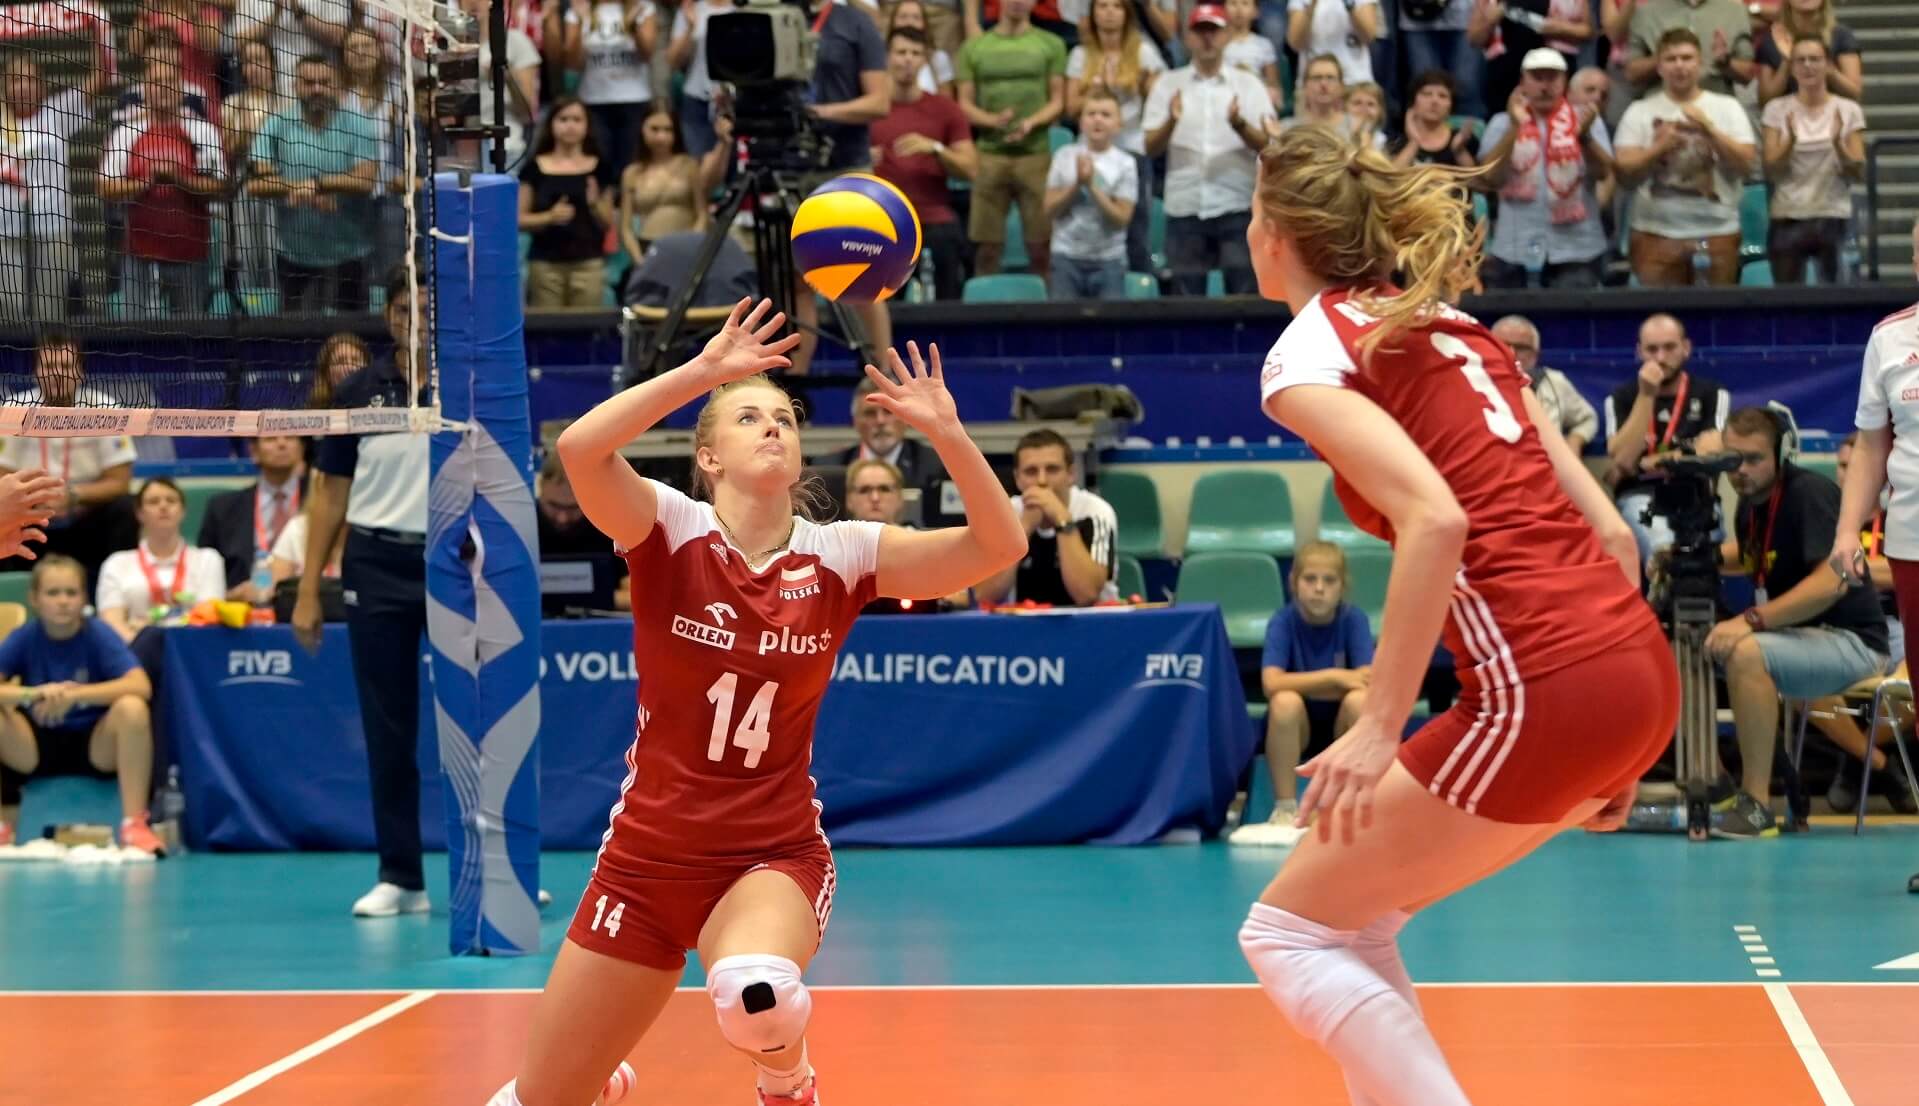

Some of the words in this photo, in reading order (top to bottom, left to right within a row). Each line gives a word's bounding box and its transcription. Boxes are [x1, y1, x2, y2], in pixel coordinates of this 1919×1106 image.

[1430, 332, 1522, 443] 3
[779, 583, 821, 600] POLSKA
[675, 619, 731, 647] ORLEN
[228, 650, 292, 675] FIVB
[835, 652, 1065, 685] ALIFICATION
[1145, 653, 1204, 678] FIVB
[706, 672, 779, 769] 14
[591, 895, 626, 938] 14
